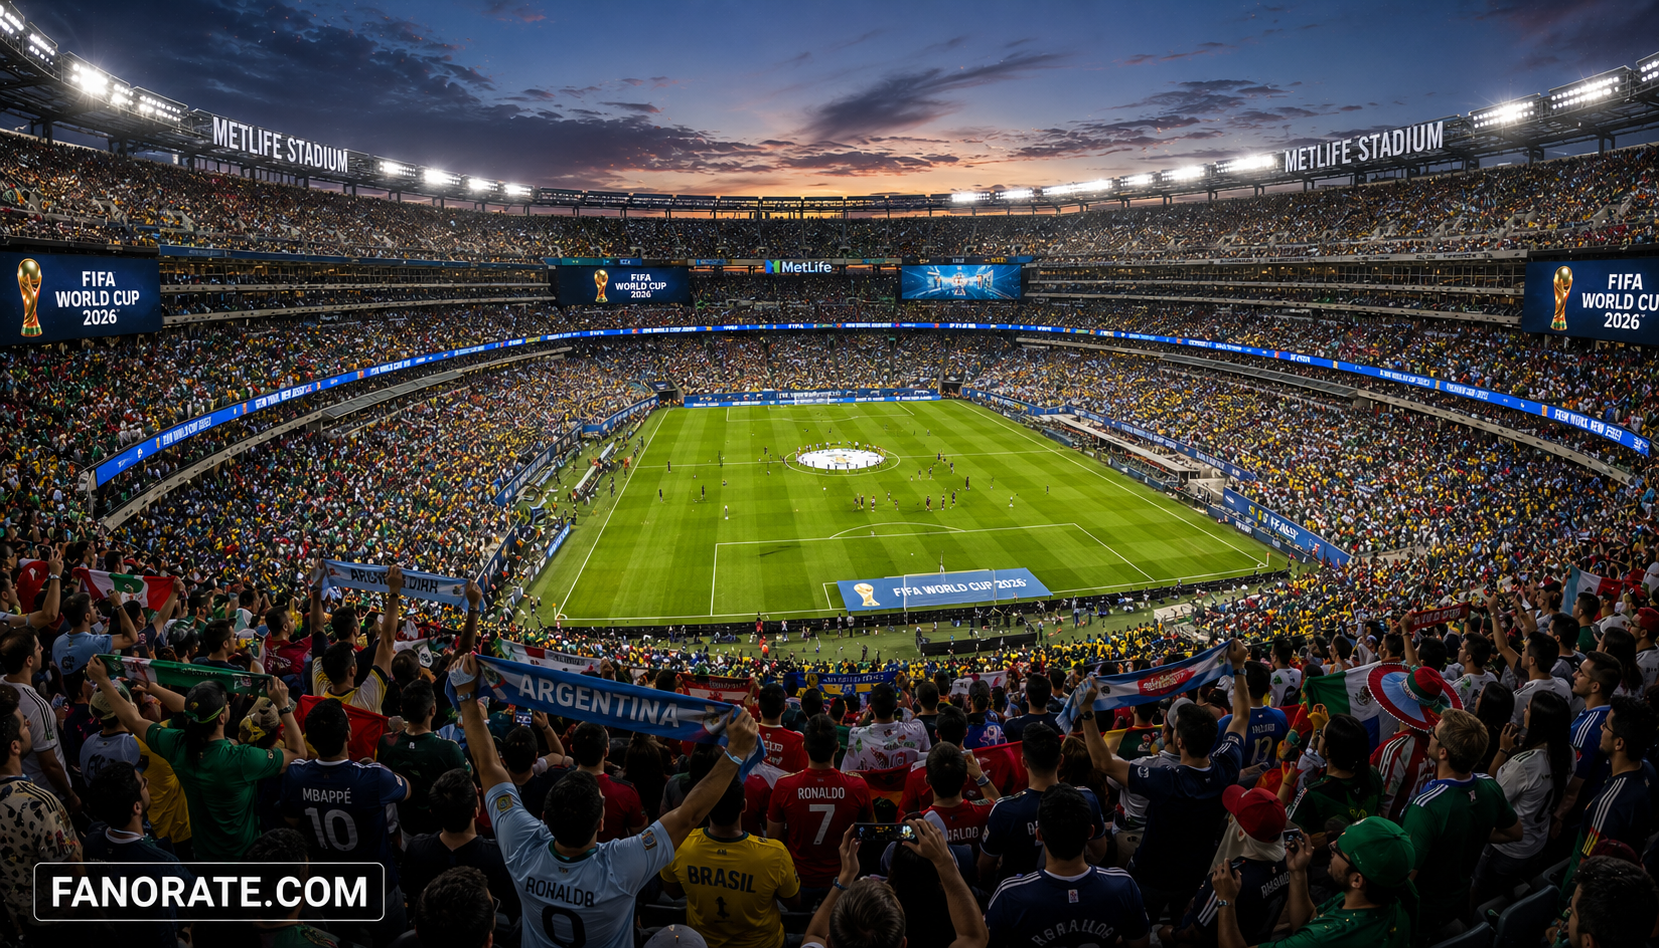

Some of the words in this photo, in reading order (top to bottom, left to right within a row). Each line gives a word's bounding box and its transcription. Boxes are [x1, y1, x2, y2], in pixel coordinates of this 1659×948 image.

[213, 116, 282, 160] METLIFE
[287, 137, 348, 173] STADIUM
[1285, 138, 1352, 173] METLIFE
[1358, 121, 1444, 162] STADIUM
[782, 261, 832, 273] MetLife
[82, 271, 115, 287] FIFA
[615, 282, 647, 290] WORLD
[649, 282, 667, 290] CUP
[630, 273, 652, 282] FIFA
[1607, 273, 1643, 290] FIFA
[55, 290, 109, 308] WORLD
[113, 290, 140, 306] CUP
[630, 290, 652, 299] 2026
[1582, 292, 1634, 310] WORLD
[1638, 294, 1659, 311] CU
[83, 309, 117, 326] 2026
[1604, 312, 1640, 330] 2026
[893, 586, 922, 597] FIFA
[922, 583, 968, 595] WORLD
[968, 580, 992, 591] CUP
[995, 578, 1026, 589] 2026
[518, 673, 679, 728] ARGENTINA
[302, 787, 352, 804] MBAPPÉ
[797, 786, 845, 800] RONALDO
[304, 807, 358, 852] 10
[809, 804, 836, 845] 7
[687, 865, 756, 894] BRASIL
